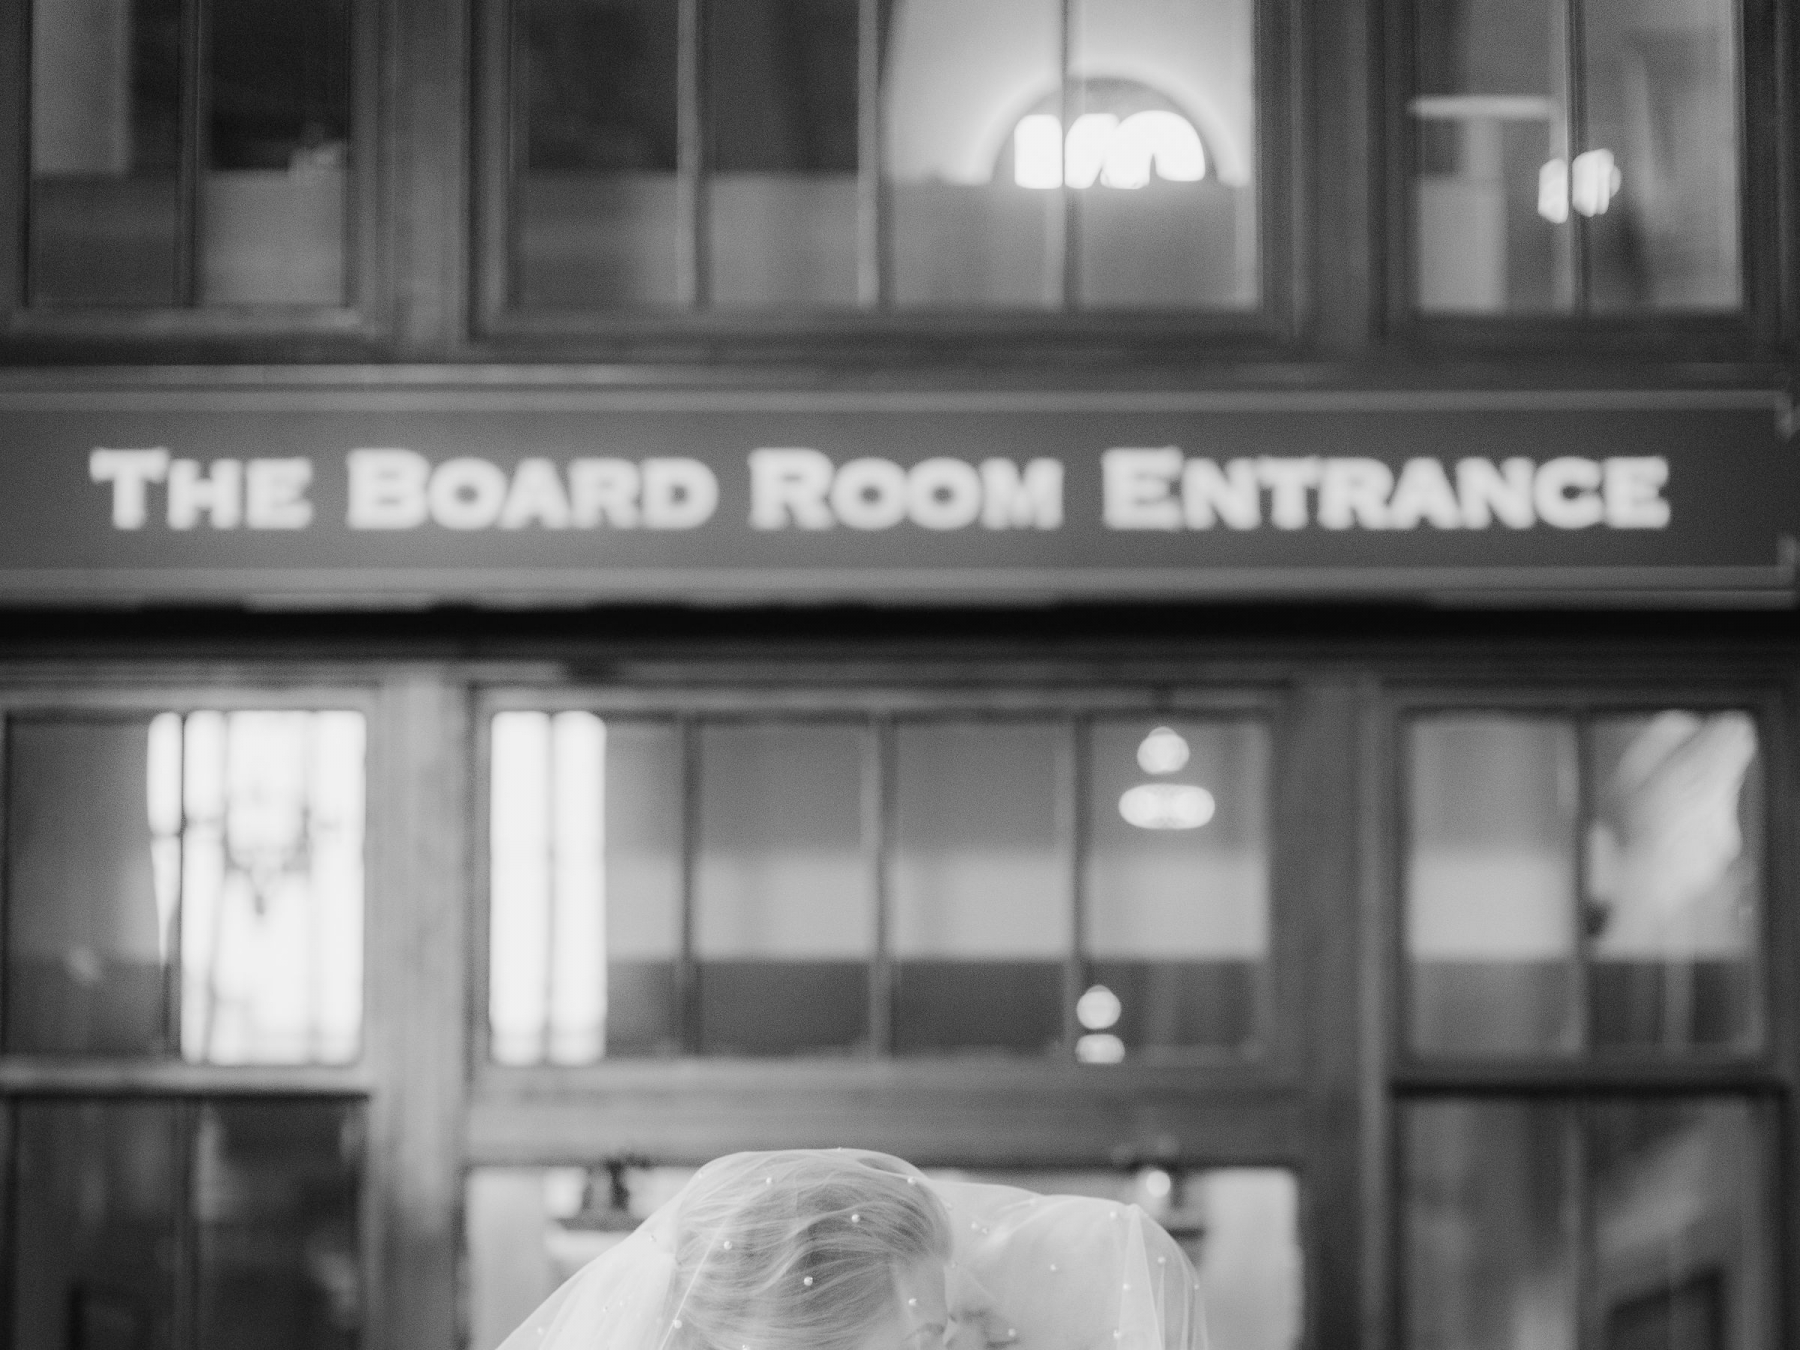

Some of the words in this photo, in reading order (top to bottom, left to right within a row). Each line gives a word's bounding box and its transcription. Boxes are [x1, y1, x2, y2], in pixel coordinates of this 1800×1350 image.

[89, 447, 315, 532] THE
[344, 446, 720, 532] BOARD
[746, 446, 1064, 532] ROOM
[1101, 446, 1671, 532] ENTRANCE
